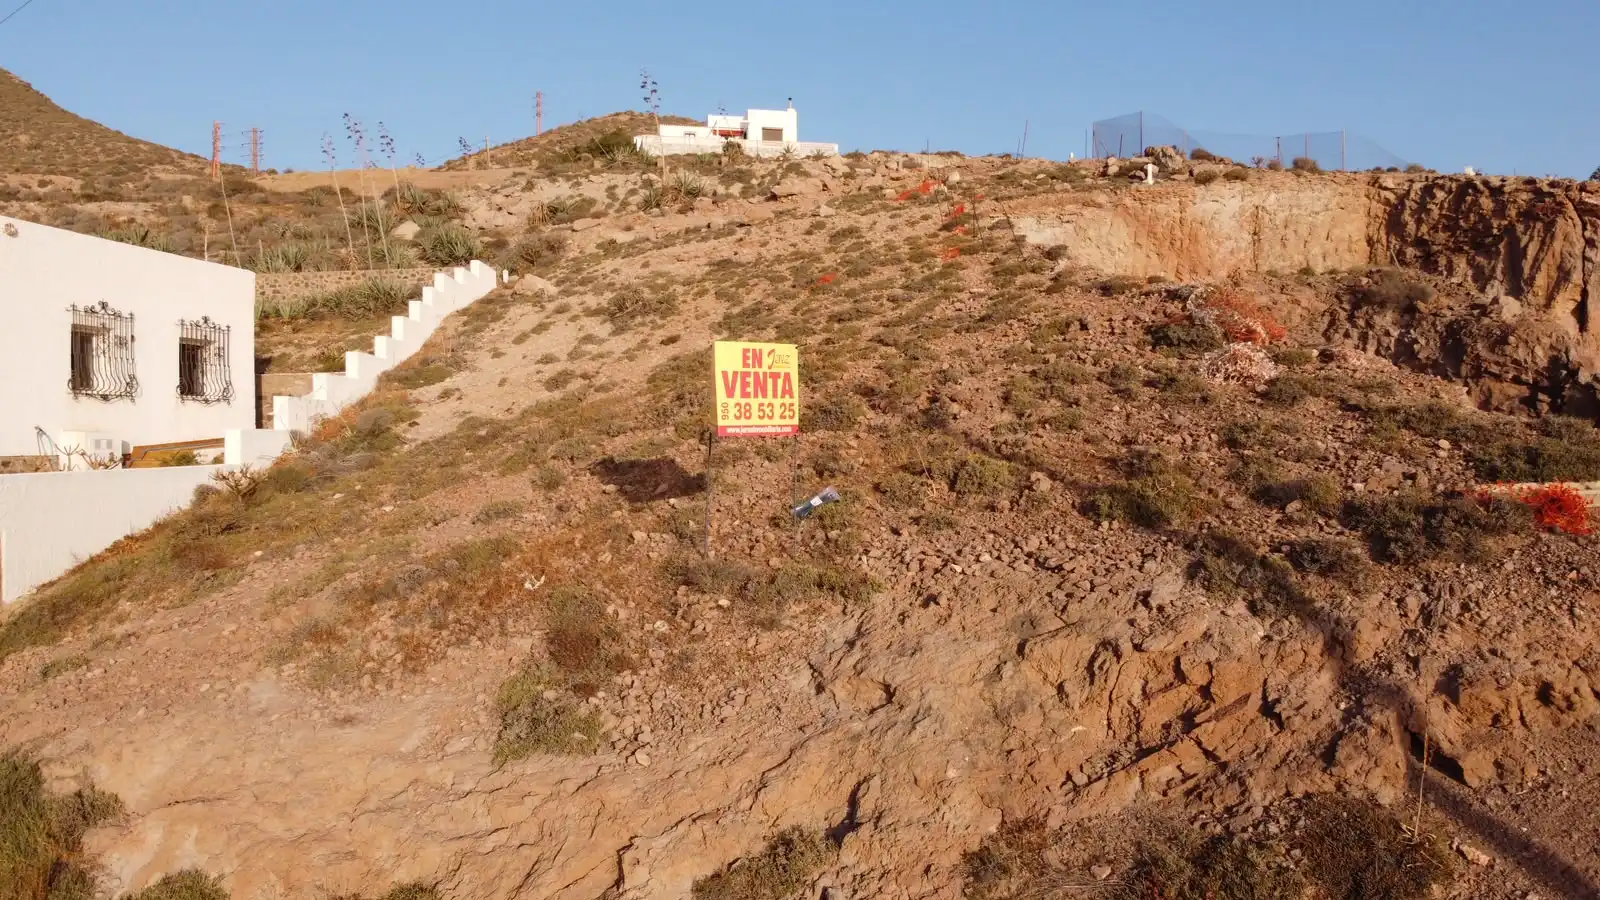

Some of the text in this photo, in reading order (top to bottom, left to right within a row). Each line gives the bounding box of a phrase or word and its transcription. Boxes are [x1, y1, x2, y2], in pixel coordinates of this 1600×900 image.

[742, 348, 763, 369] EN
[721, 370, 794, 399] VENTA
[721, 402, 729, 421] 950
[734, 402, 795, 420] 38 53 25
